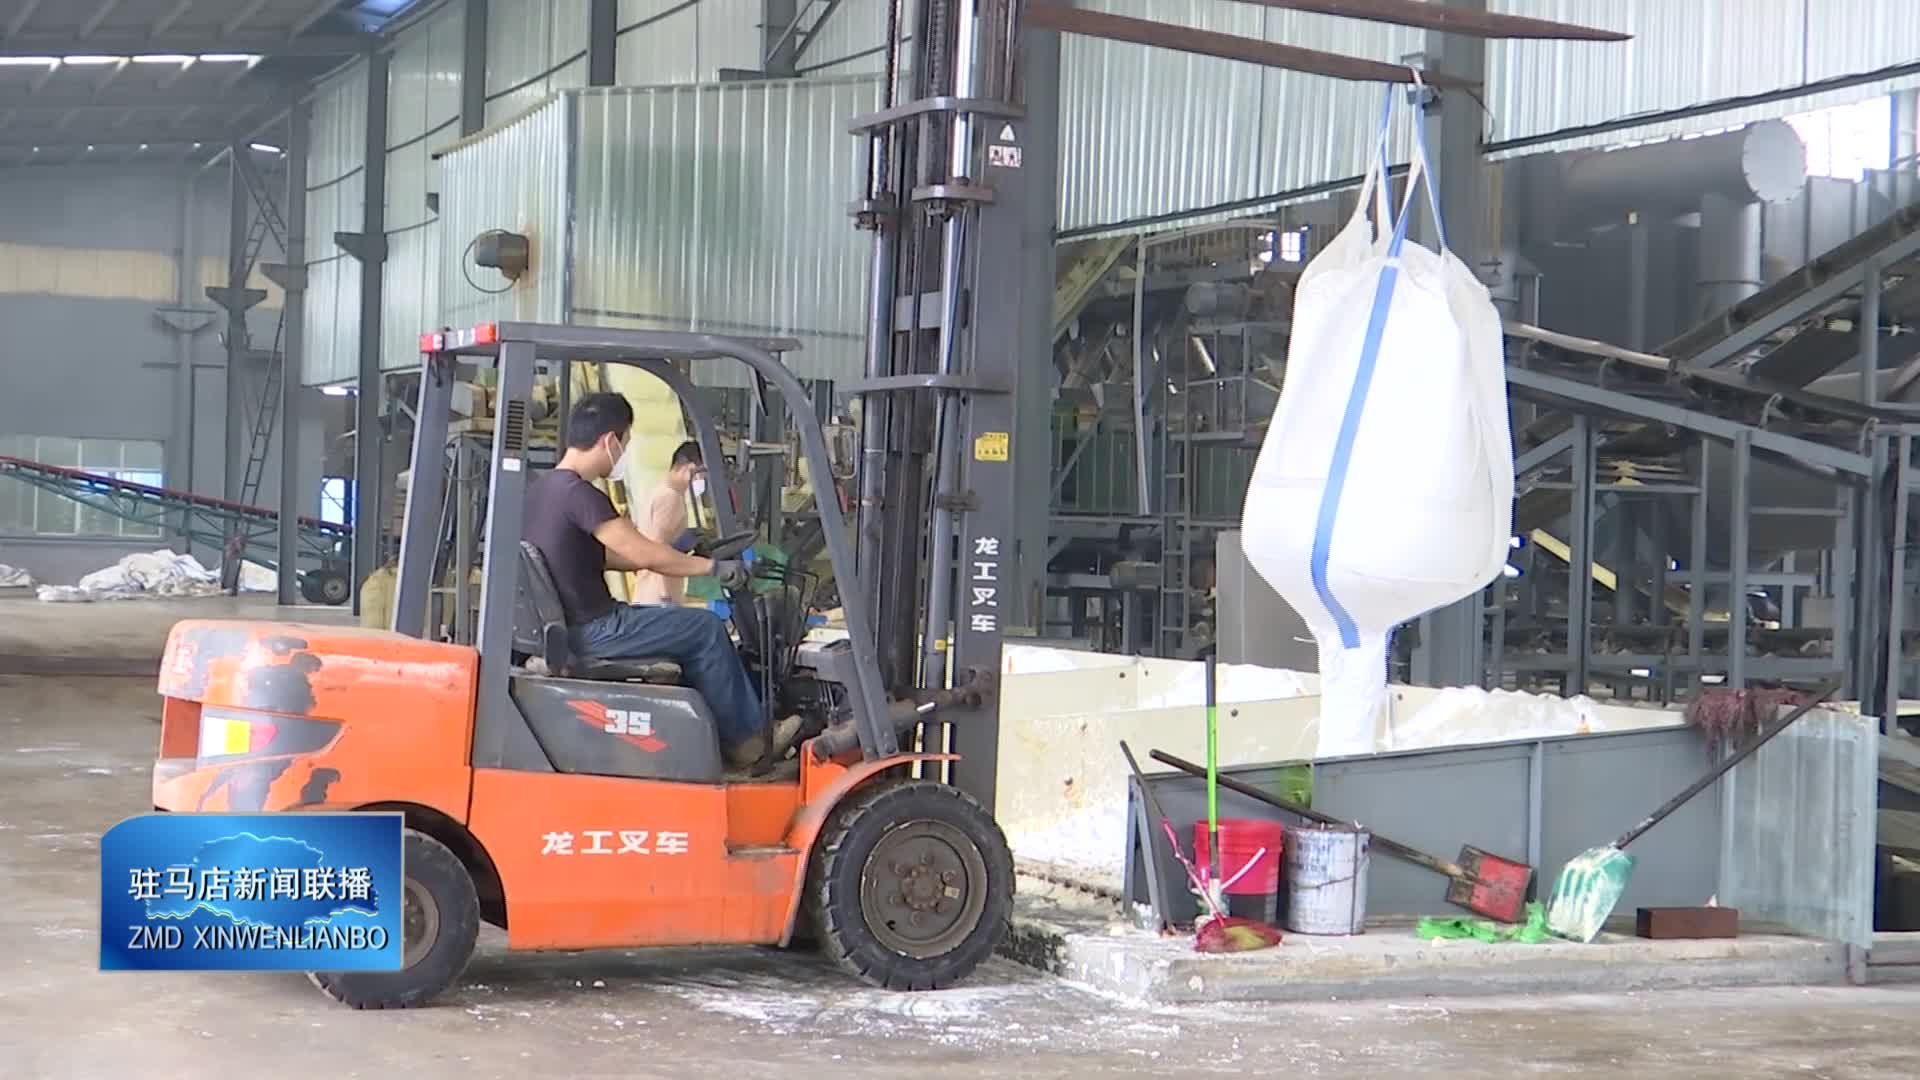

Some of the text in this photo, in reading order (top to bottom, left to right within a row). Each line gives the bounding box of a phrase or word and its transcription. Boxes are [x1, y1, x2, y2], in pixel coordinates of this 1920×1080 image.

[972, 537, 999, 632] 龙工叉车
[605, 709, 651, 736] 35
[541, 830, 688, 854] 龙工叉车
